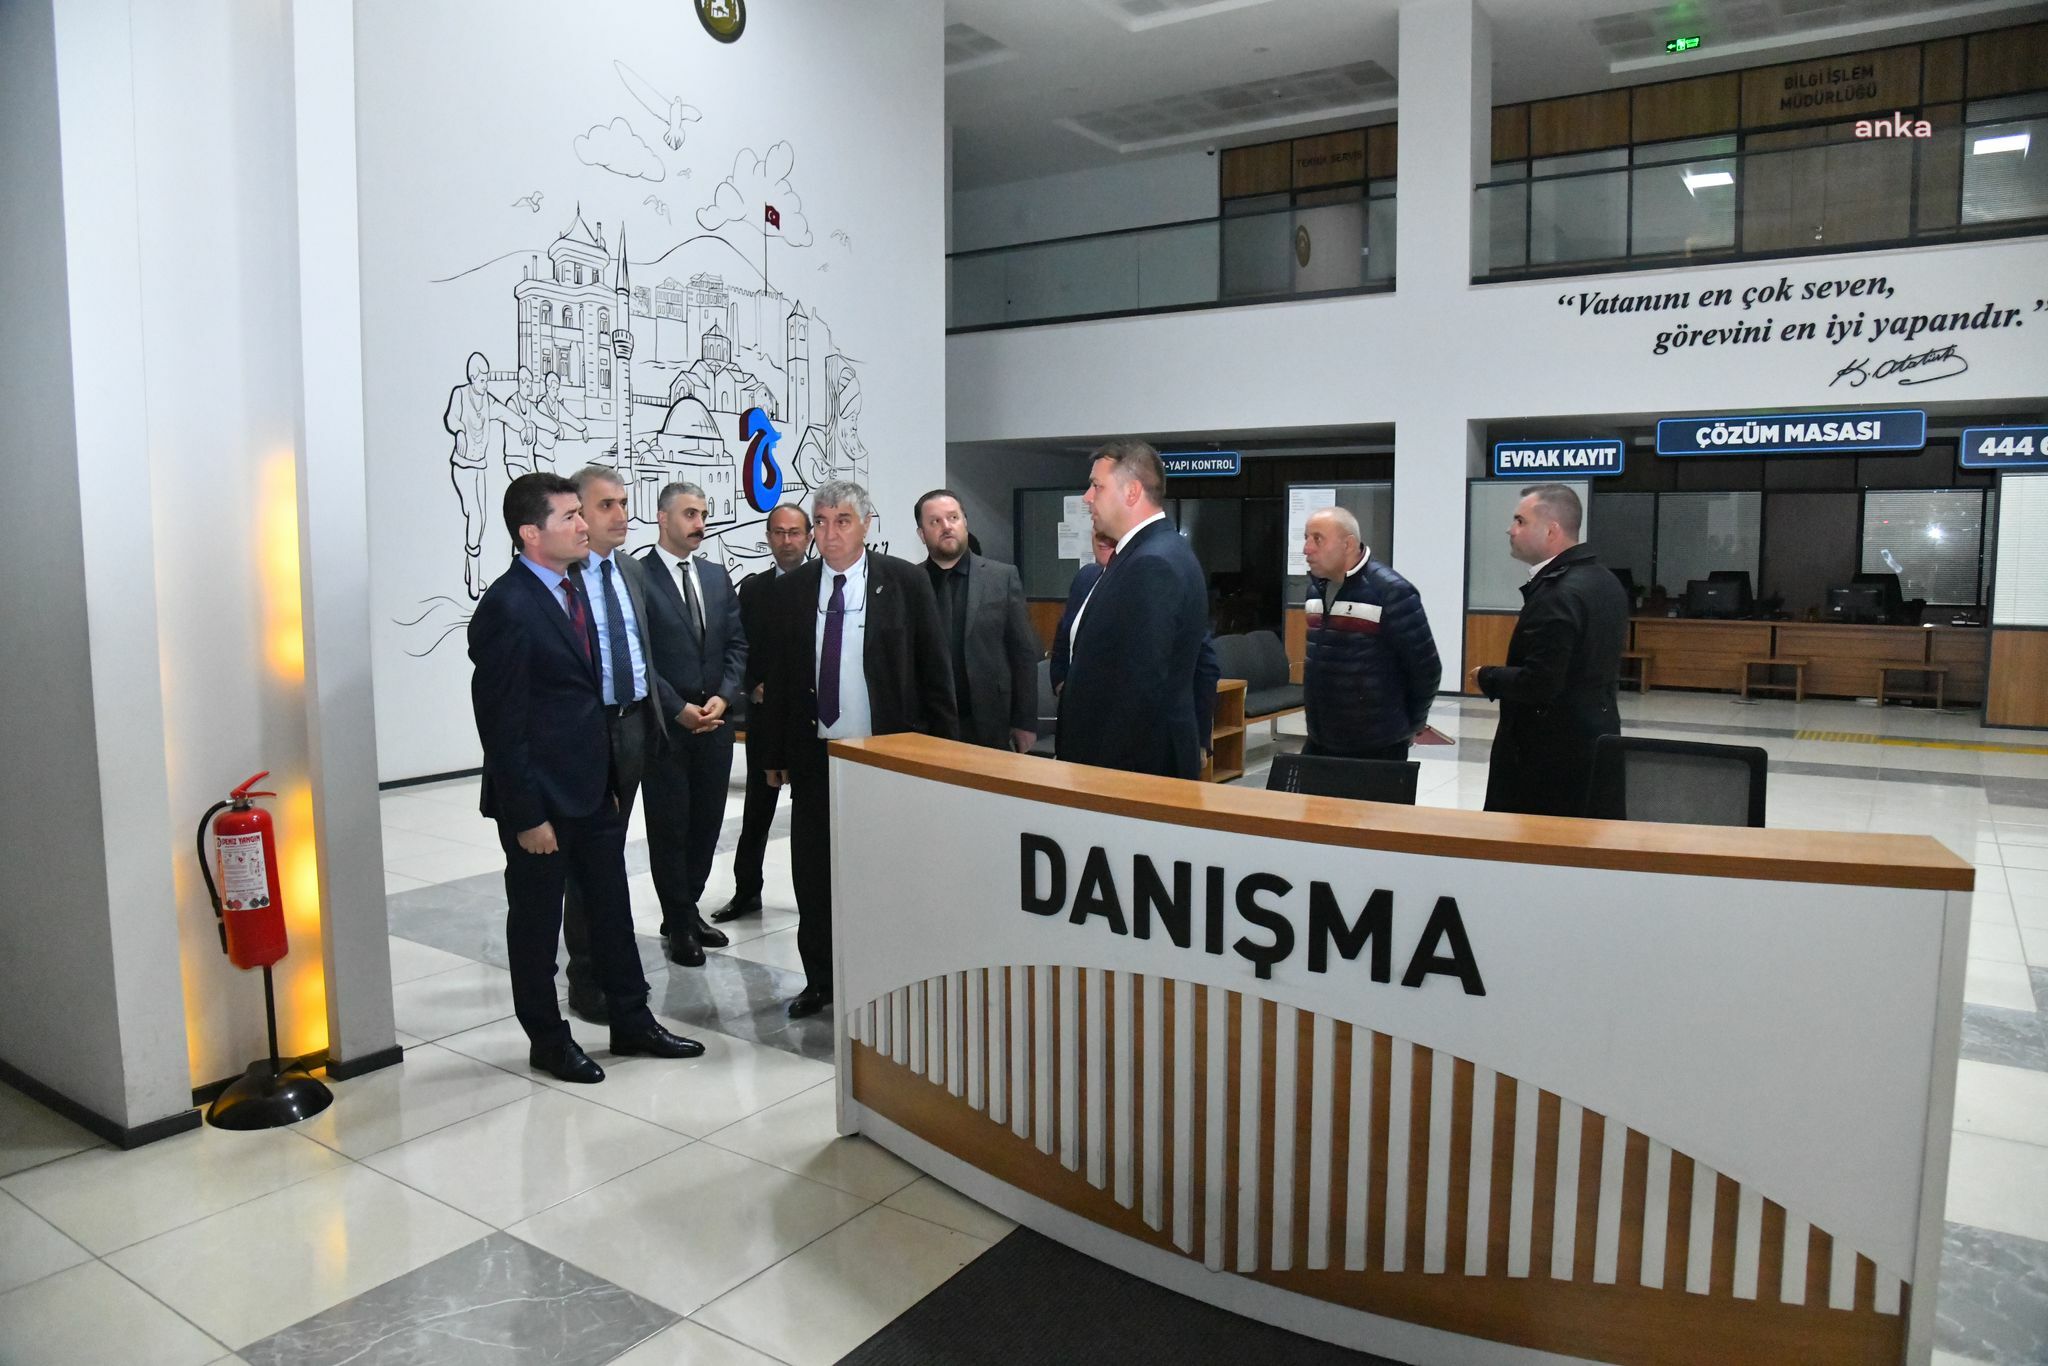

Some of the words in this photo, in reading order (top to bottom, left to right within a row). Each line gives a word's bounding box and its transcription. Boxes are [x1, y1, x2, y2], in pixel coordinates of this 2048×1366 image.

[1784, 69, 1823, 90] BİLGİ
[1827, 65, 1874, 85] İŞLEM
[1780, 81, 1877, 110] MÜDÜRLÜĞÜ
[1698, 287, 1733, 307] en
[1741, 277, 1794, 310] çok
[1801, 277, 1895, 300] seven,
[1653, 318, 1773, 355] görevini
[1780, 319, 1816, 342] en
[1825, 311, 1865, 345] iyi
[1695, 422, 1780, 448] ÇÖZÜM
[1784, 421, 1881, 443] MASASI
[1978, 436, 2034, 456] 444
[1191, 460, 1235, 470] KONTROL
[1500, 450, 1560, 468] EVRAK
[1563, 448, 1616, 466] KAYIT
[1020, 832, 1486, 996] DANIŞMA
